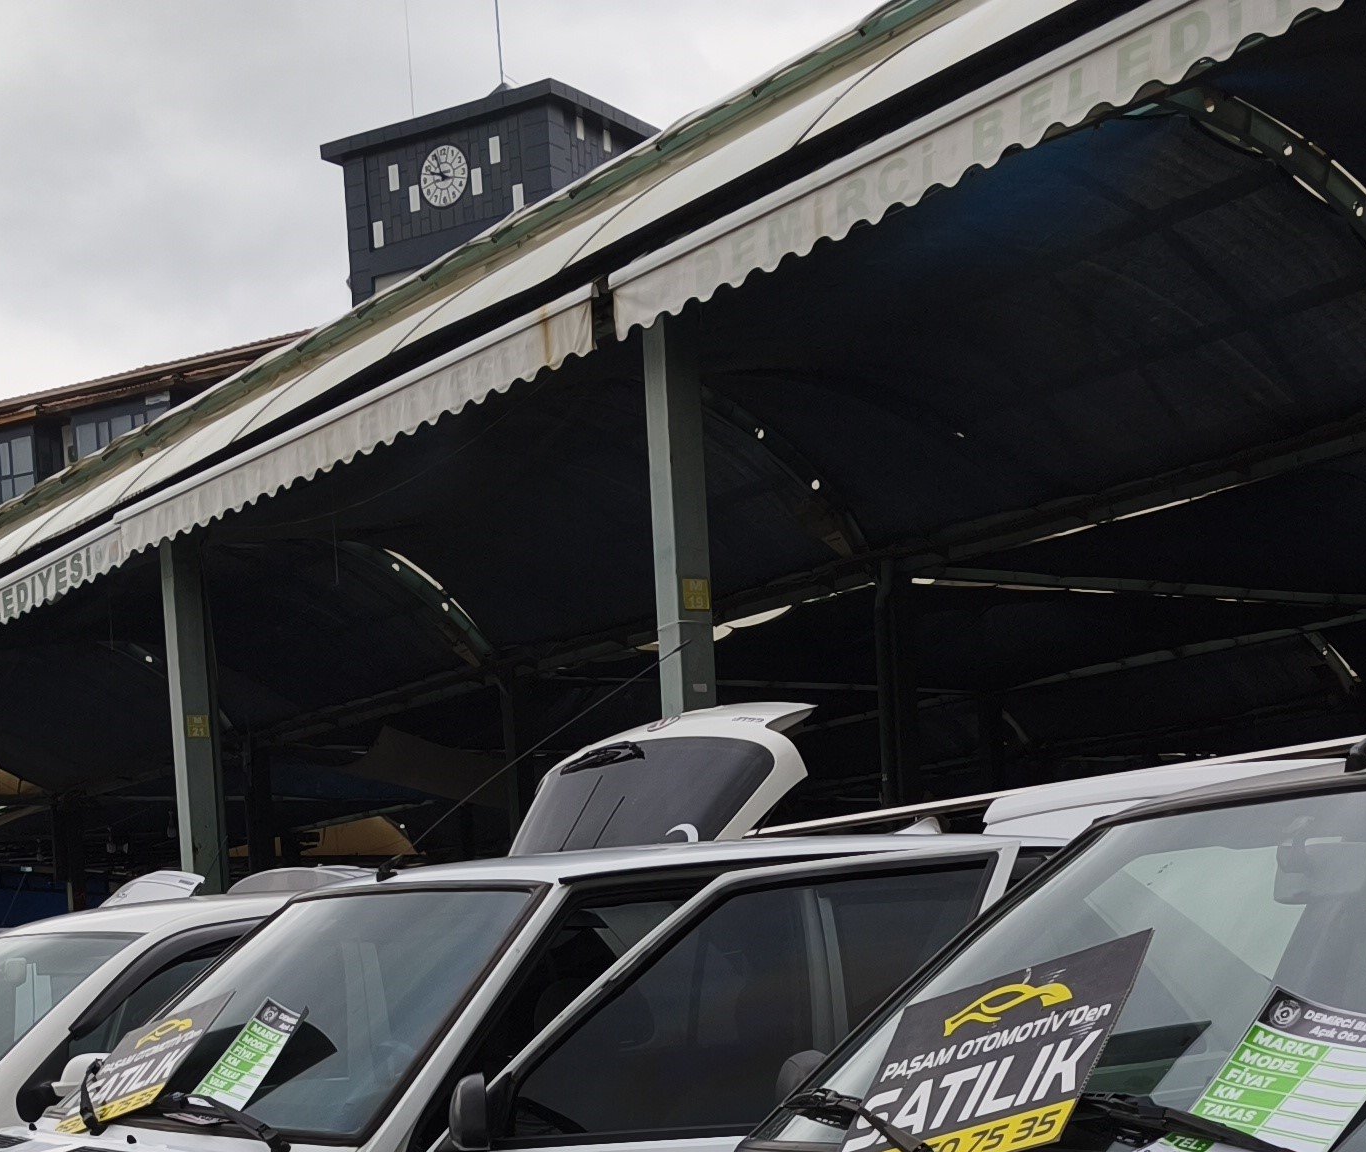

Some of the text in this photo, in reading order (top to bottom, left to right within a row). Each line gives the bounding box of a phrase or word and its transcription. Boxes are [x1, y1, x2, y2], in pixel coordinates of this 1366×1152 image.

[880, 1002, 1112, 1083] PAŞAM OTOMOTİV'Den
[1252, 1030, 1320, 1058] MARKA
[1338, 1031, 1357, 1042] Oto
[1238, 1051, 1300, 1074] MODEL
[1226, 1066, 1277, 1090] FİYAT
[1213, 1084, 1241, 1101] KM
[1201, 1103, 1259, 1123] TAKAS
[1011, 1109, 1062, 1143] 35
[1173, 1135, 1206, 1150] TEL:
